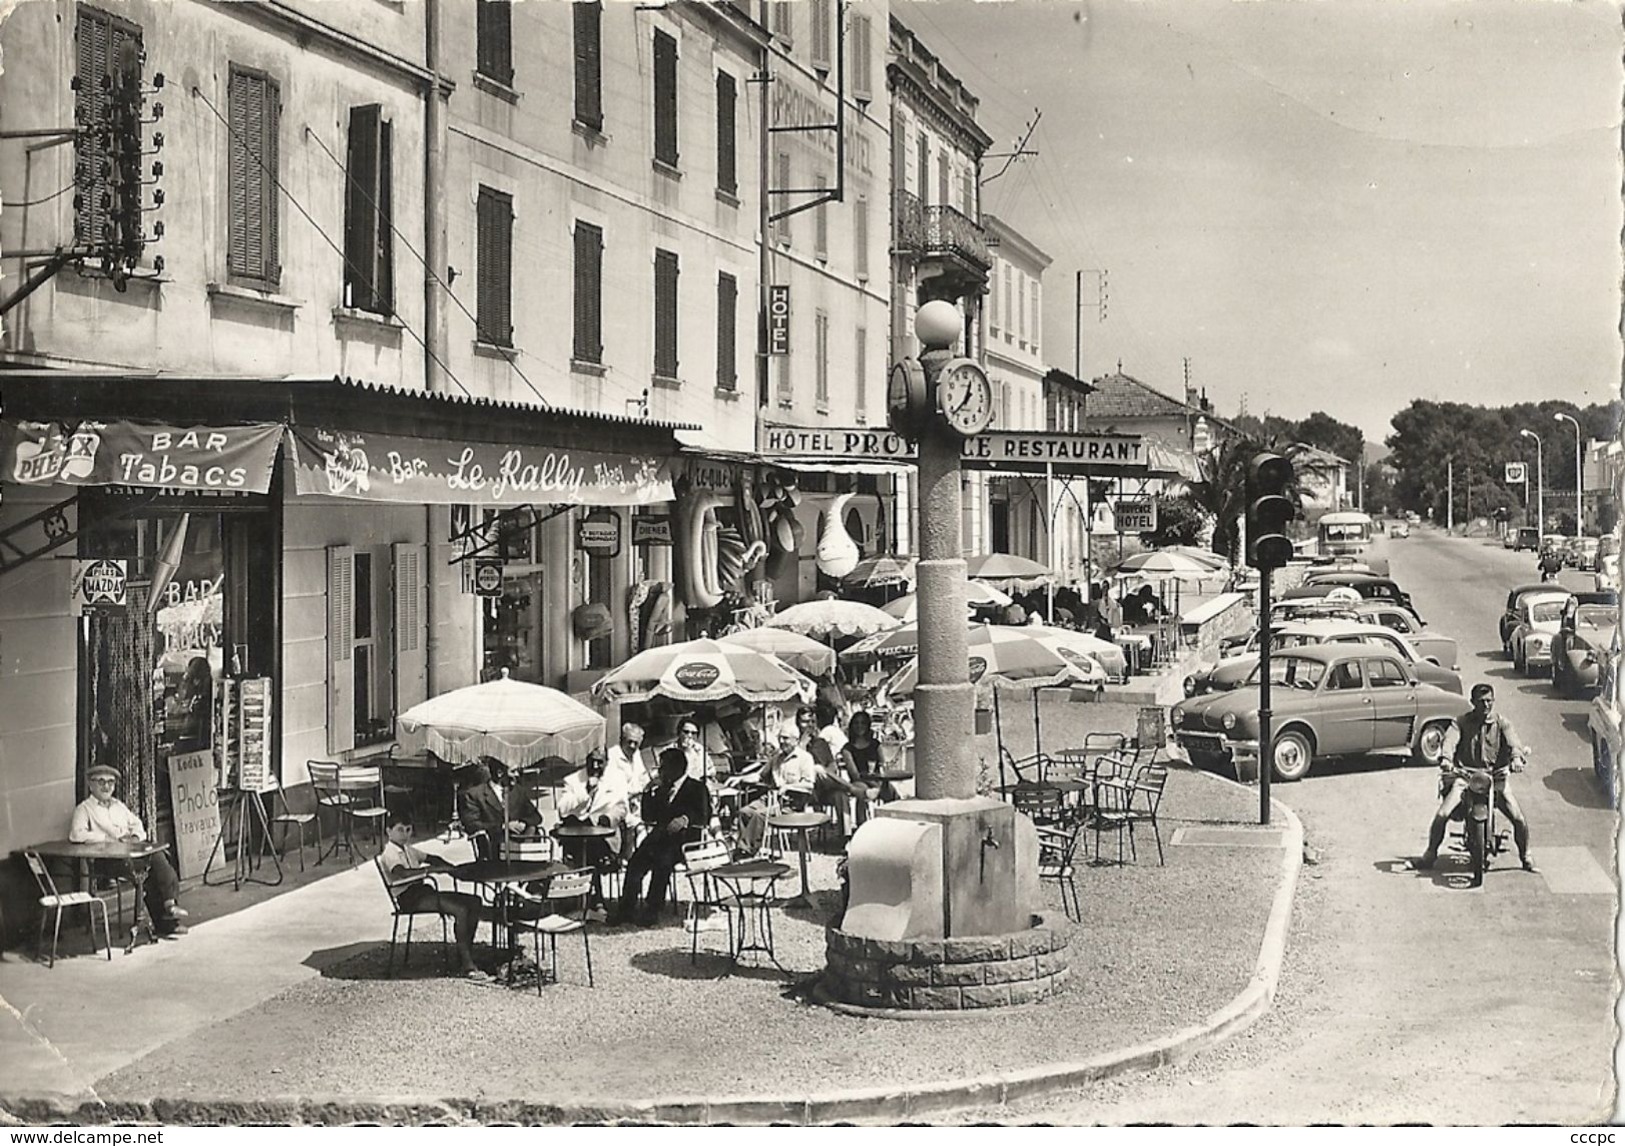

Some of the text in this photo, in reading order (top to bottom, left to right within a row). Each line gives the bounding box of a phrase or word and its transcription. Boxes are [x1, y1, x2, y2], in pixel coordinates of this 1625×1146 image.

[772, 289, 788, 353] HOTEL
[151, 431, 228, 452] BAR
[1004, 439, 1142, 460] RESTAURANT
[120, 452, 248, 487] Tabacs
[387, 451, 428, 484] Bar
[447, 447, 486, 490] Le
[492, 449, 585, 502] Rally
[1116, 503, 1152, 514] PROVENCE
[1116, 515, 1153, 528] HOTEL
[87, 577, 120, 593] MAZDA
[177, 754, 204, 772] Kodak
